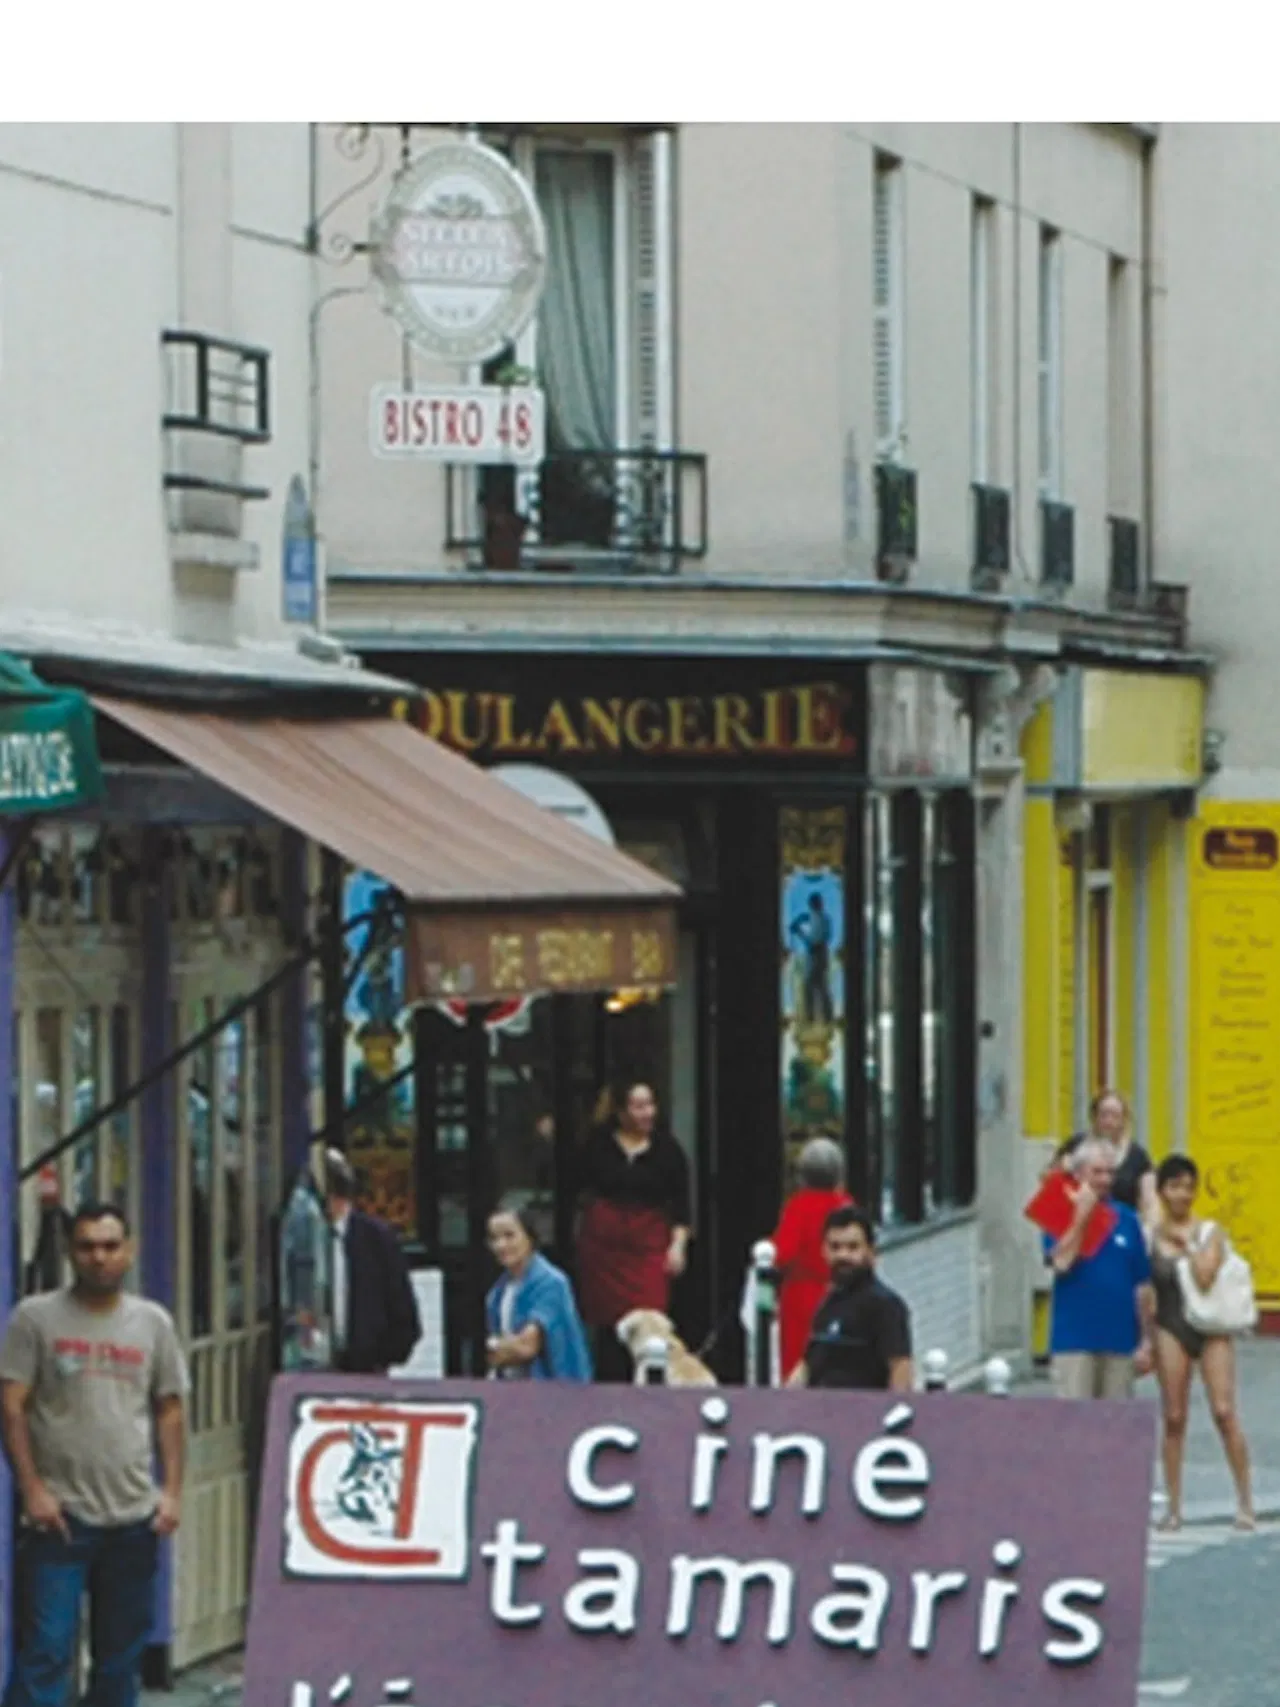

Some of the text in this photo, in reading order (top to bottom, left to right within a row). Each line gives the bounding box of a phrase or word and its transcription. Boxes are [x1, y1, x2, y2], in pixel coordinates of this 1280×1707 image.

[384, 399, 532, 447] BISTRO 48
[391, 684, 850, 752] OULANGERIE
[566, 1398, 933, 1522] ciné
[480, 1518, 1108, 1665] tamaris
